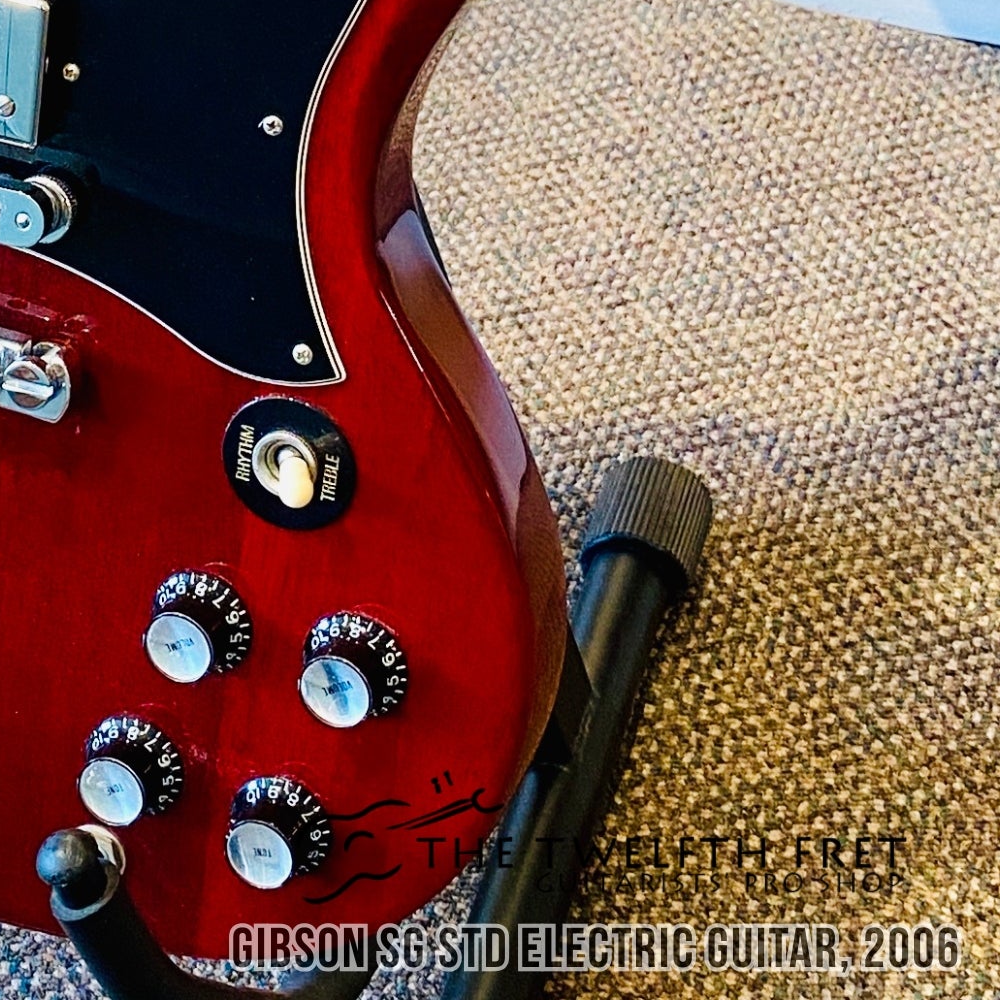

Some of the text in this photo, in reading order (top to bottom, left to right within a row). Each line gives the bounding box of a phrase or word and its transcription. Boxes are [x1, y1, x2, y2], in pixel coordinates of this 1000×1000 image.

[235, 424, 255, 482] RHYTHM
[320, 453, 340, 501] TREBLE
[194, 581, 207, 597] 8
[212, 595, 226, 609] 7
[225, 610, 239, 624] 6
[230, 632, 242, 643] 5
[367, 635, 381, 650] 7
[381, 652, 395, 667] 6
[387, 675, 399, 686] 5
[127, 726, 139, 741] 8
[144, 737, 158, 752] 7
[157, 754, 171, 768] 6
[162, 775, 175, 786] 5
[286, 792, 299, 807] 8
[301, 809, 315, 823] 7
[310, 829, 321, 841] 6
